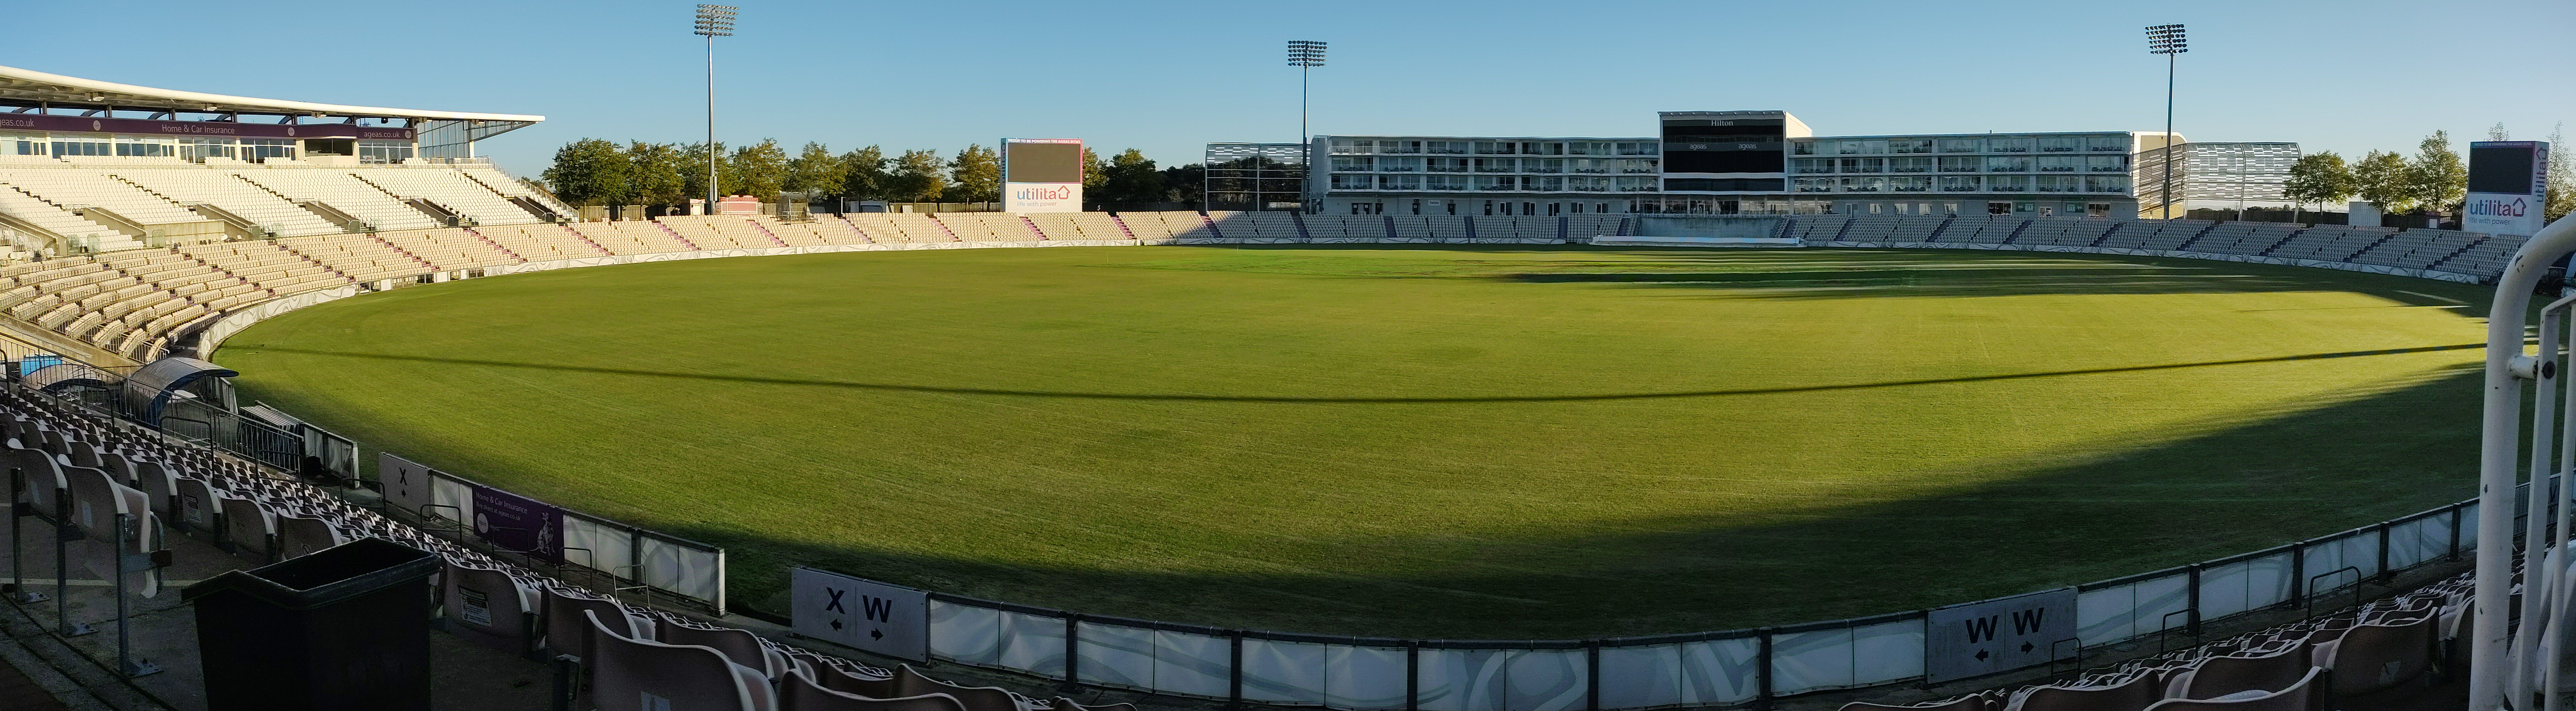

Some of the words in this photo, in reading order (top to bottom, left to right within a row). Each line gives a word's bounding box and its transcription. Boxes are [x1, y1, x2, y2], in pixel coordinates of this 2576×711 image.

[162, 124, 182, 132] Home
[2535, 162, 2546, 203] utilita
[1017, 188, 1056, 200] utilita
[2470, 200, 2511, 216] utilita
[399, 467, 407, 486] X
[476, 492, 489, 502] Home
[504, 501, 527, 514] Insurance
[826, 587, 846, 613] X
[862, 595, 892, 623] W
[1966, 615, 1998, 644] W
[2013, 607, 2044, 636] W
